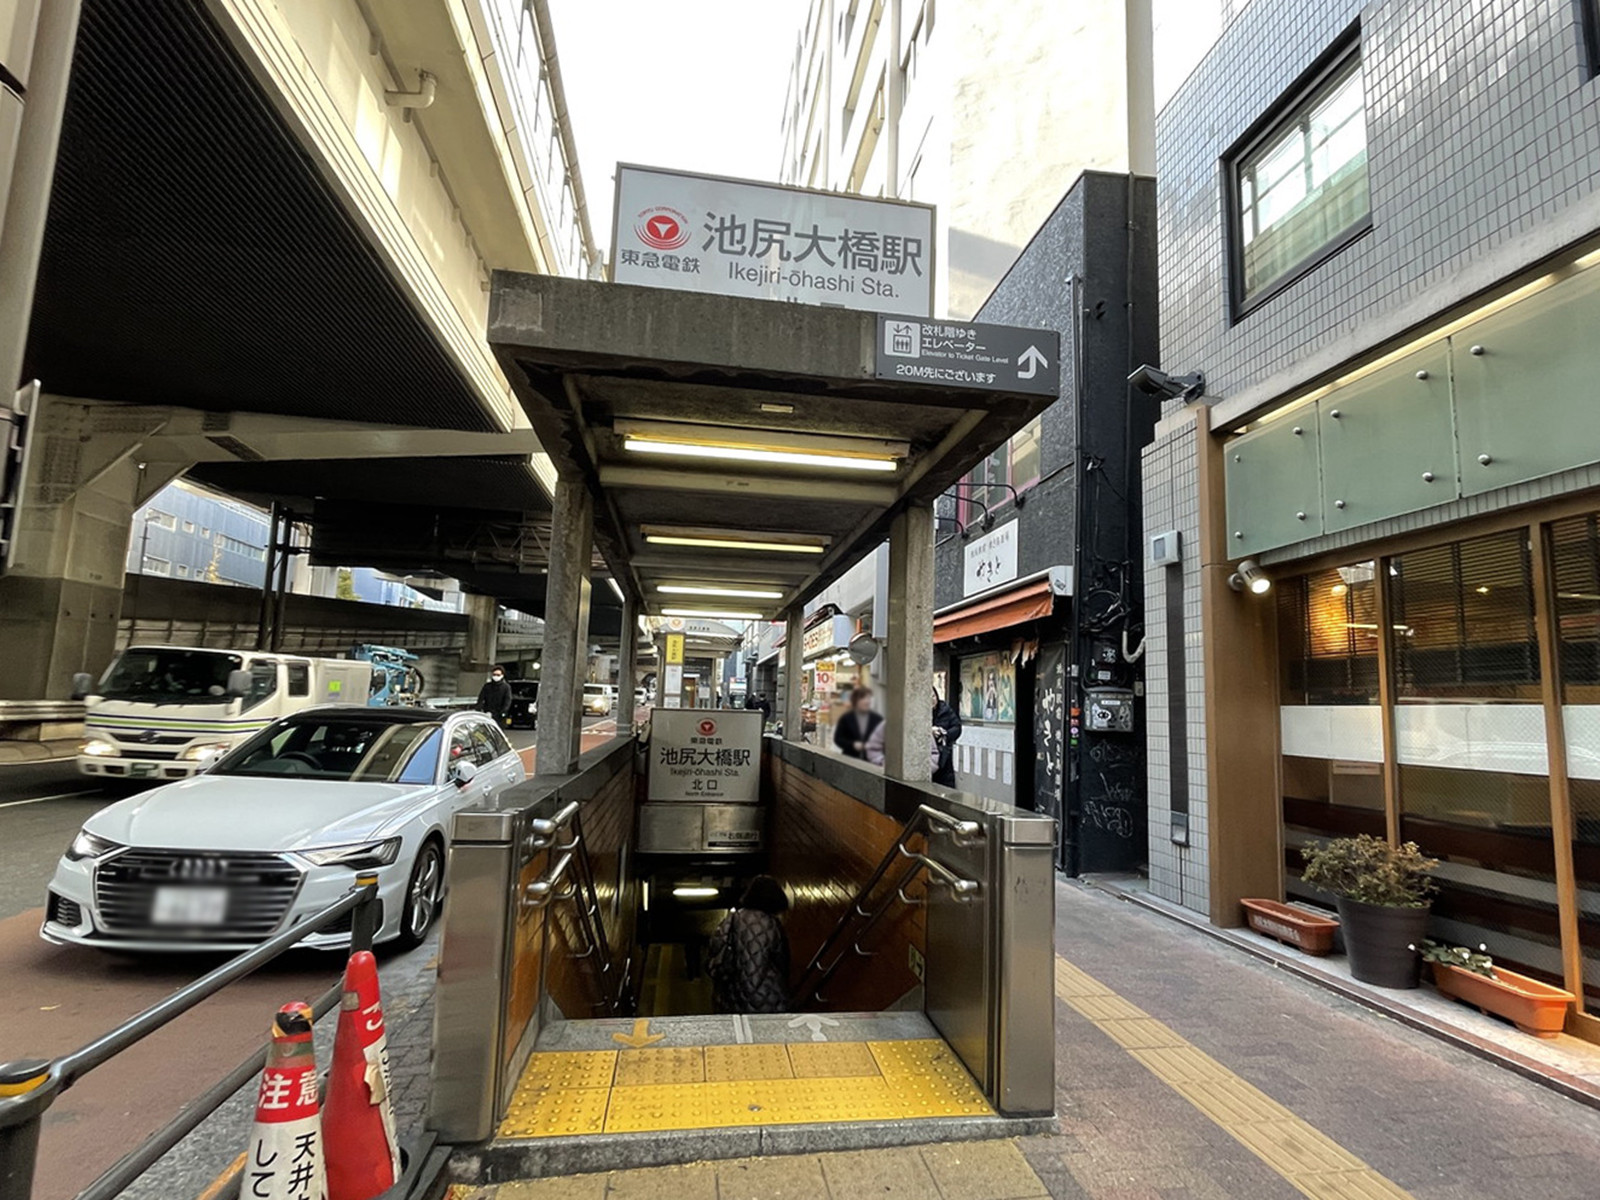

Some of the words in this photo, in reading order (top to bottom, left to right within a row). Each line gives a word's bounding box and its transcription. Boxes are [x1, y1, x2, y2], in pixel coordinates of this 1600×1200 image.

[701, 211, 923, 277] 池尻大橋駅
[620, 248, 700, 274] 東急電鉄
[728, 261, 855, 293] Ikejiri-ōhashi
[861, 277, 900, 298] Sta.
[922, 323, 977, 340] 改札階ゆき
[922, 338, 986, 352] エレベーター
[956, 352, 974, 361] Ticket
[975, 354, 991, 362] Gate
[992, 356, 1009, 364] Level
[896, 364, 996, 384] 20M先にございます
[660, 747, 751, 767] 池尻大橋駅
[692, 779, 718, 791] 北口
[258, 1070, 319, 1109] 注意
[287, 1131, 317, 1200] 天井
